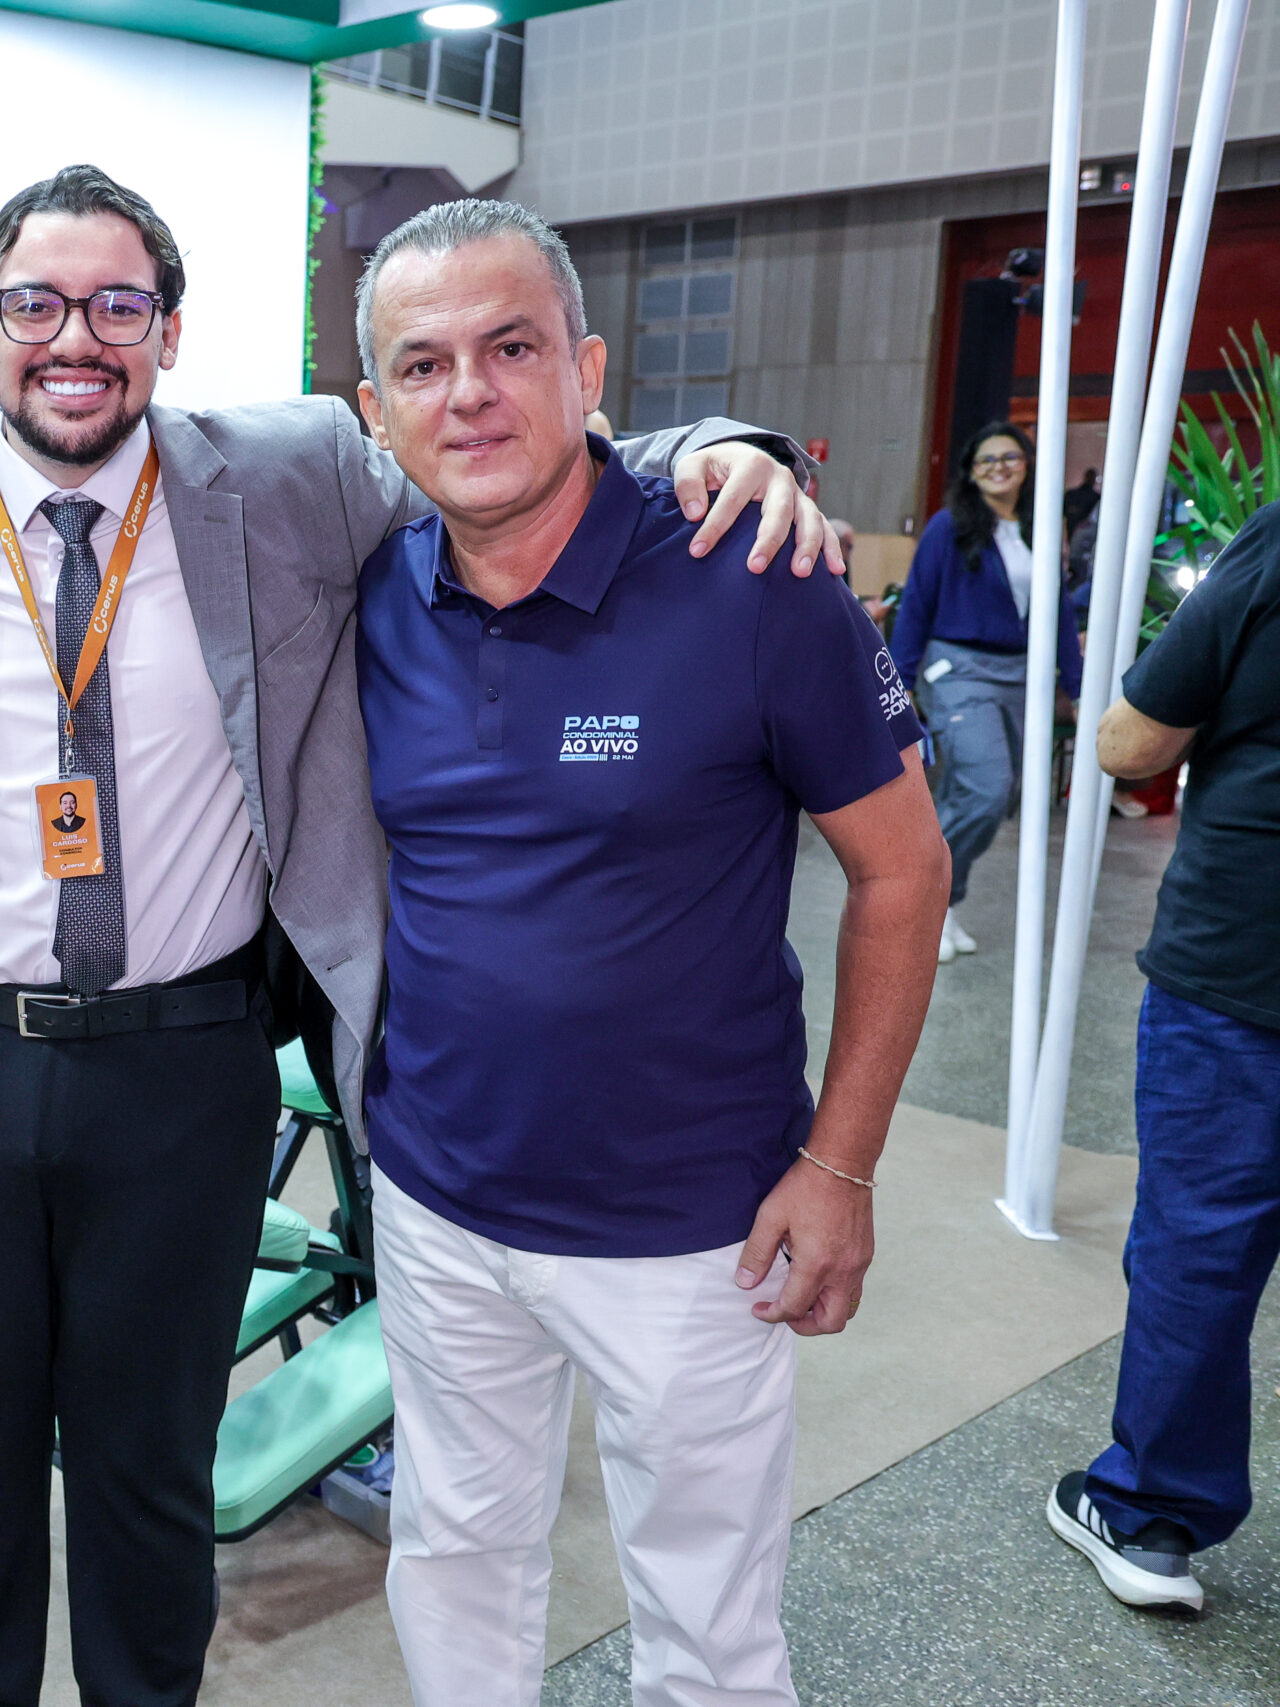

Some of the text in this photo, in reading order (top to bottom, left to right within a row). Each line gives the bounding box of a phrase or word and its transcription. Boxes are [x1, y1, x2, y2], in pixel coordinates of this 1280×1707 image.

[562, 731, 639, 739] CONDOMINIAL
[560, 739, 639, 753] AO VIVO
[61, 833, 78, 841] LUIS
[52, 838, 88, 847] CARDOSO
